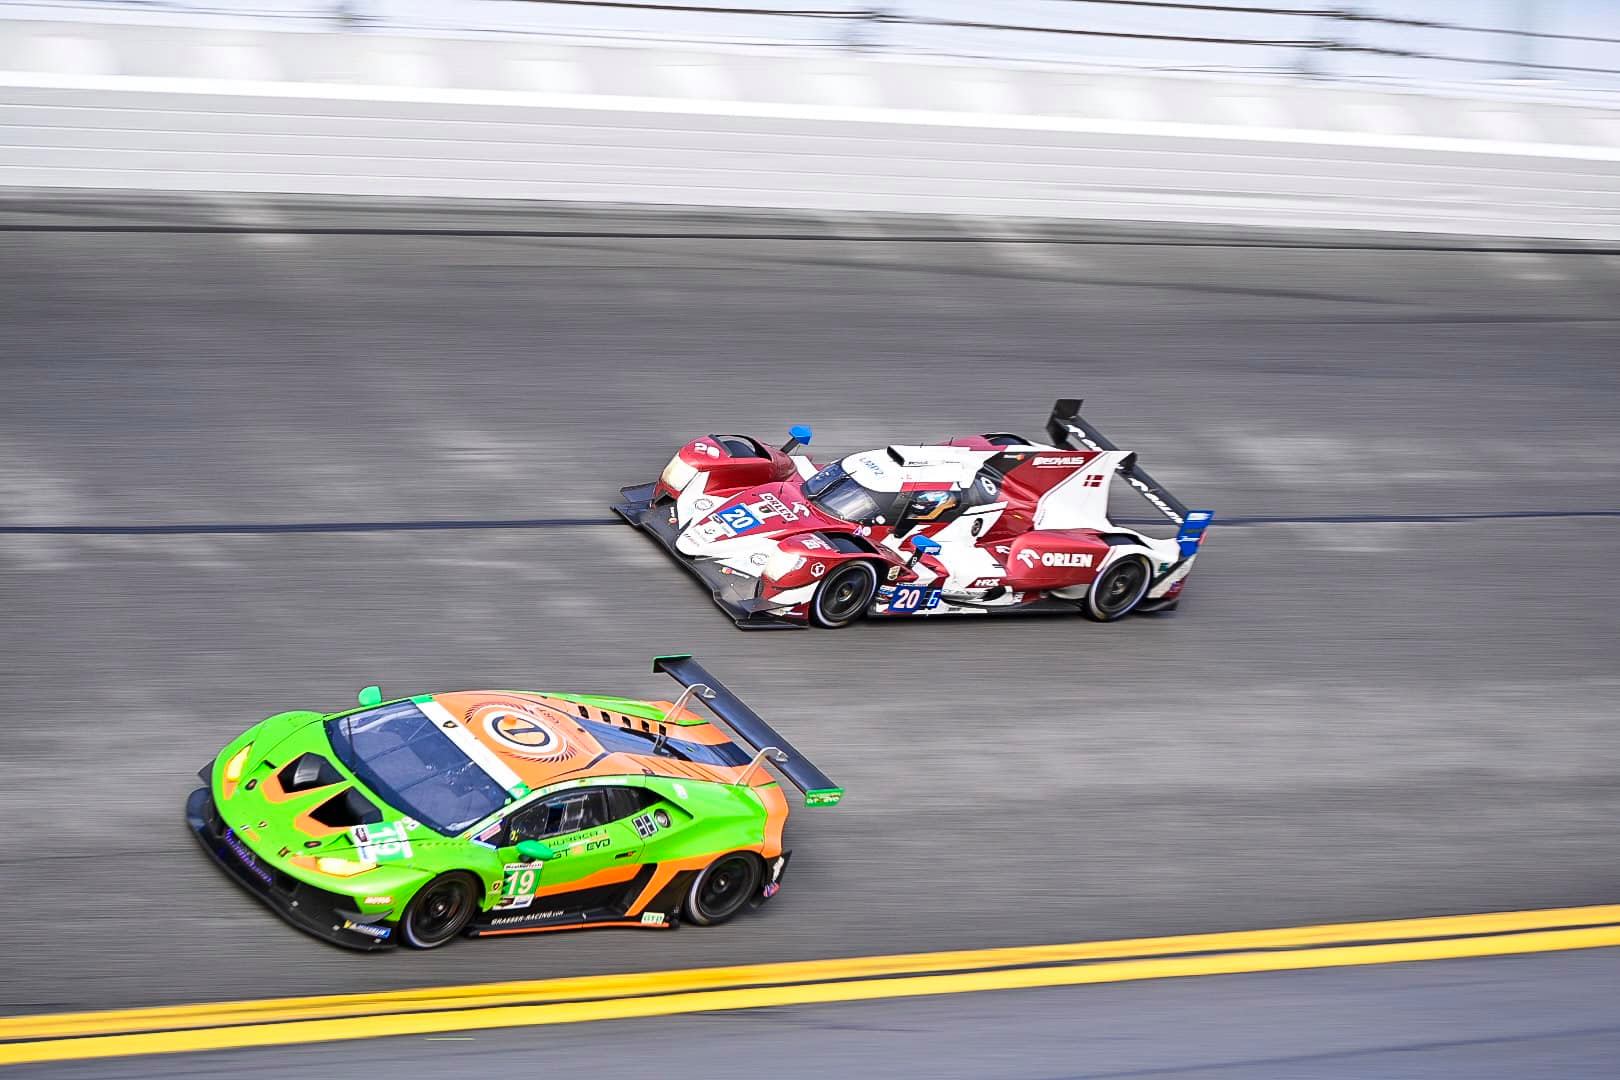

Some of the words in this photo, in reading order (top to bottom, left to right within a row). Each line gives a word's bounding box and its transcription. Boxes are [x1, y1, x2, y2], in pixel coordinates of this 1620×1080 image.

[764, 494, 794, 520] ORLEN
[722, 508, 755, 529] 20
[1041, 552, 1092, 568] ORLEN
[893, 588, 921, 609] 20
[926, 590, 940, 607] 6
[506, 870, 535, 895] 19
